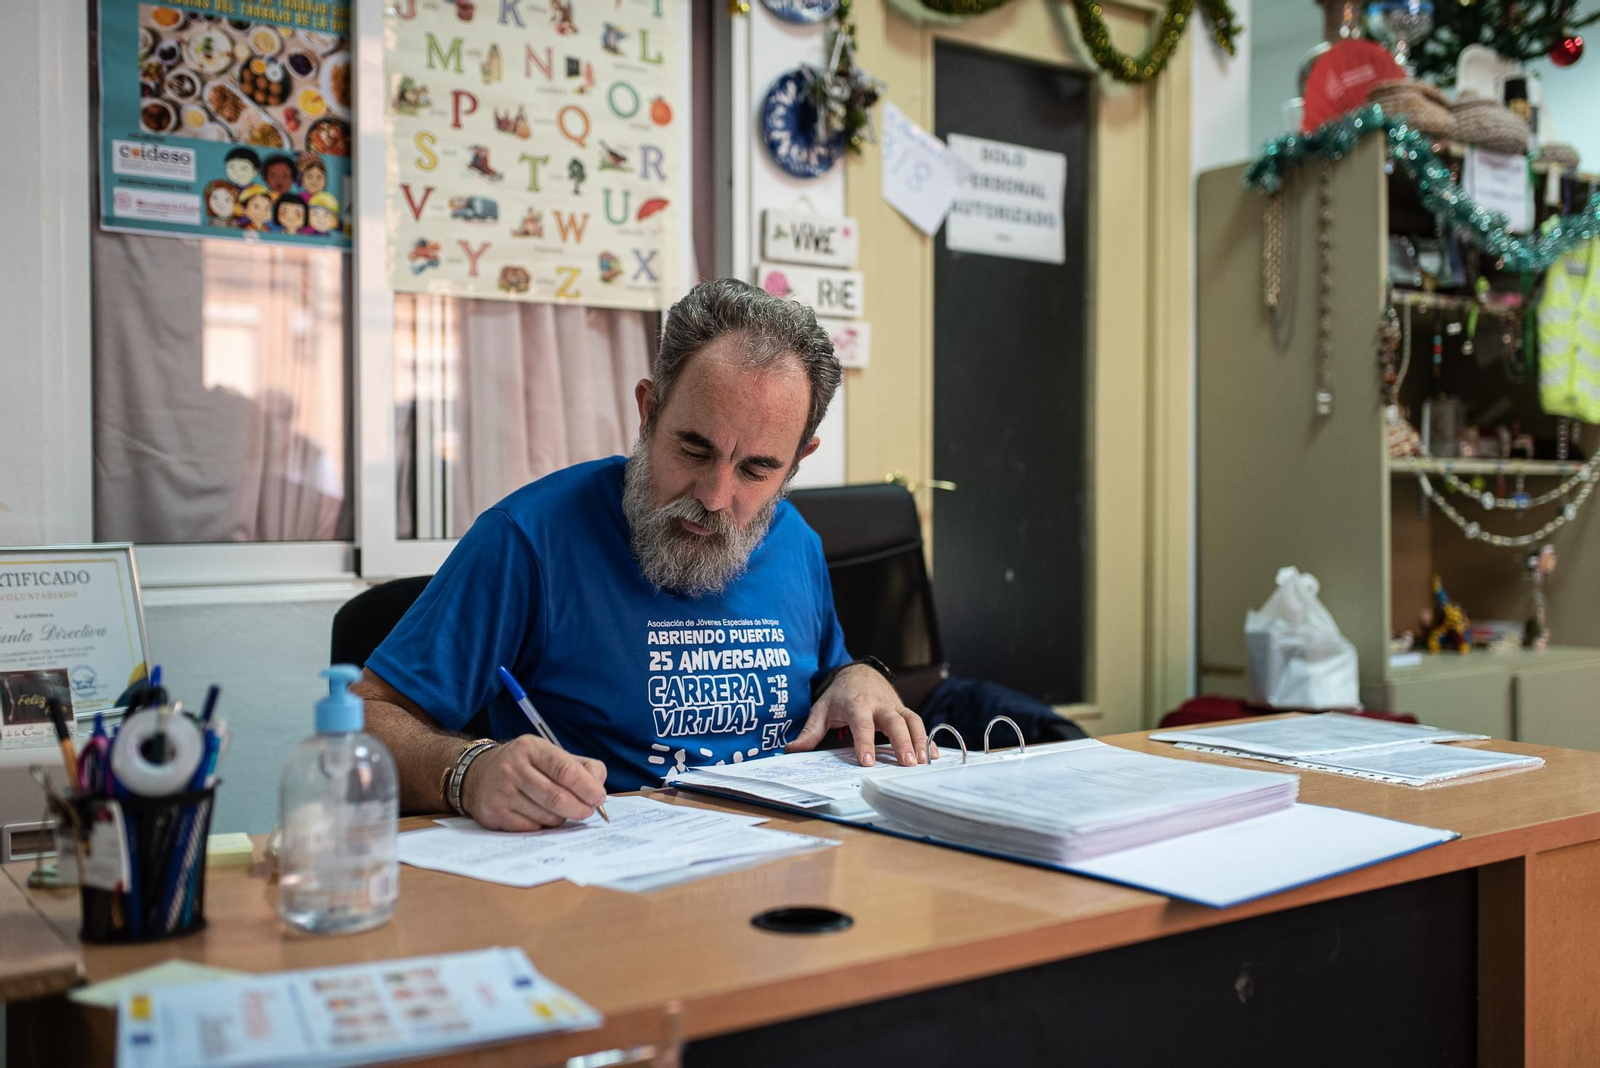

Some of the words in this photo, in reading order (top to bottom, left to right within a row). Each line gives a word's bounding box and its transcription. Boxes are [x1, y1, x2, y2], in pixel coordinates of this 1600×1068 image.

[425, 32, 465, 73] M
[524, 43, 554, 80] N
[639, 28, 663, 64] L
[450, 89, 478, 129] P
[607, 81, 640, 118] O
[557, 104, 590, 148] Q
[414, 131, 439, 171] S
[640, 144, 668, 181] R
[518, 152, 550, 193] T
[969, 172, 1046, 199] ERSONAL
[399, 183, 436, 221] V
[602, 187, 631, 226] U
[552, 209, 590, 243] W
[790, 221, 837, 255] VIVE
[456, 238, 492, 277] Y
[631, 247, 660, 282] X
[554, 266, 581, 298] Z
[41, 624, 107, 641] Directiva
[647, 619, 685, 628] Asociación
[685, 619, 695, 627] de
[696, 618, 722, 627] Jóvenes
[722, 618, 754, 628] Especiales
[647, 630, 726, 645] ABRIENDO
[729, 628, 786, 643] PUERTAS
[649, 650, 674, 671] 25
[678, 647, 791, 673] ANIVERSARIO
[648, 673, 764, 708] CARRERA
[775, 674, 788, 688] 12
[775, 689, 789, 704] 18
[652, 703, 758, 738] VIRTUAL
[768, 704, 786, 712] JULIO
[762, 719, 793, 751] 5K
